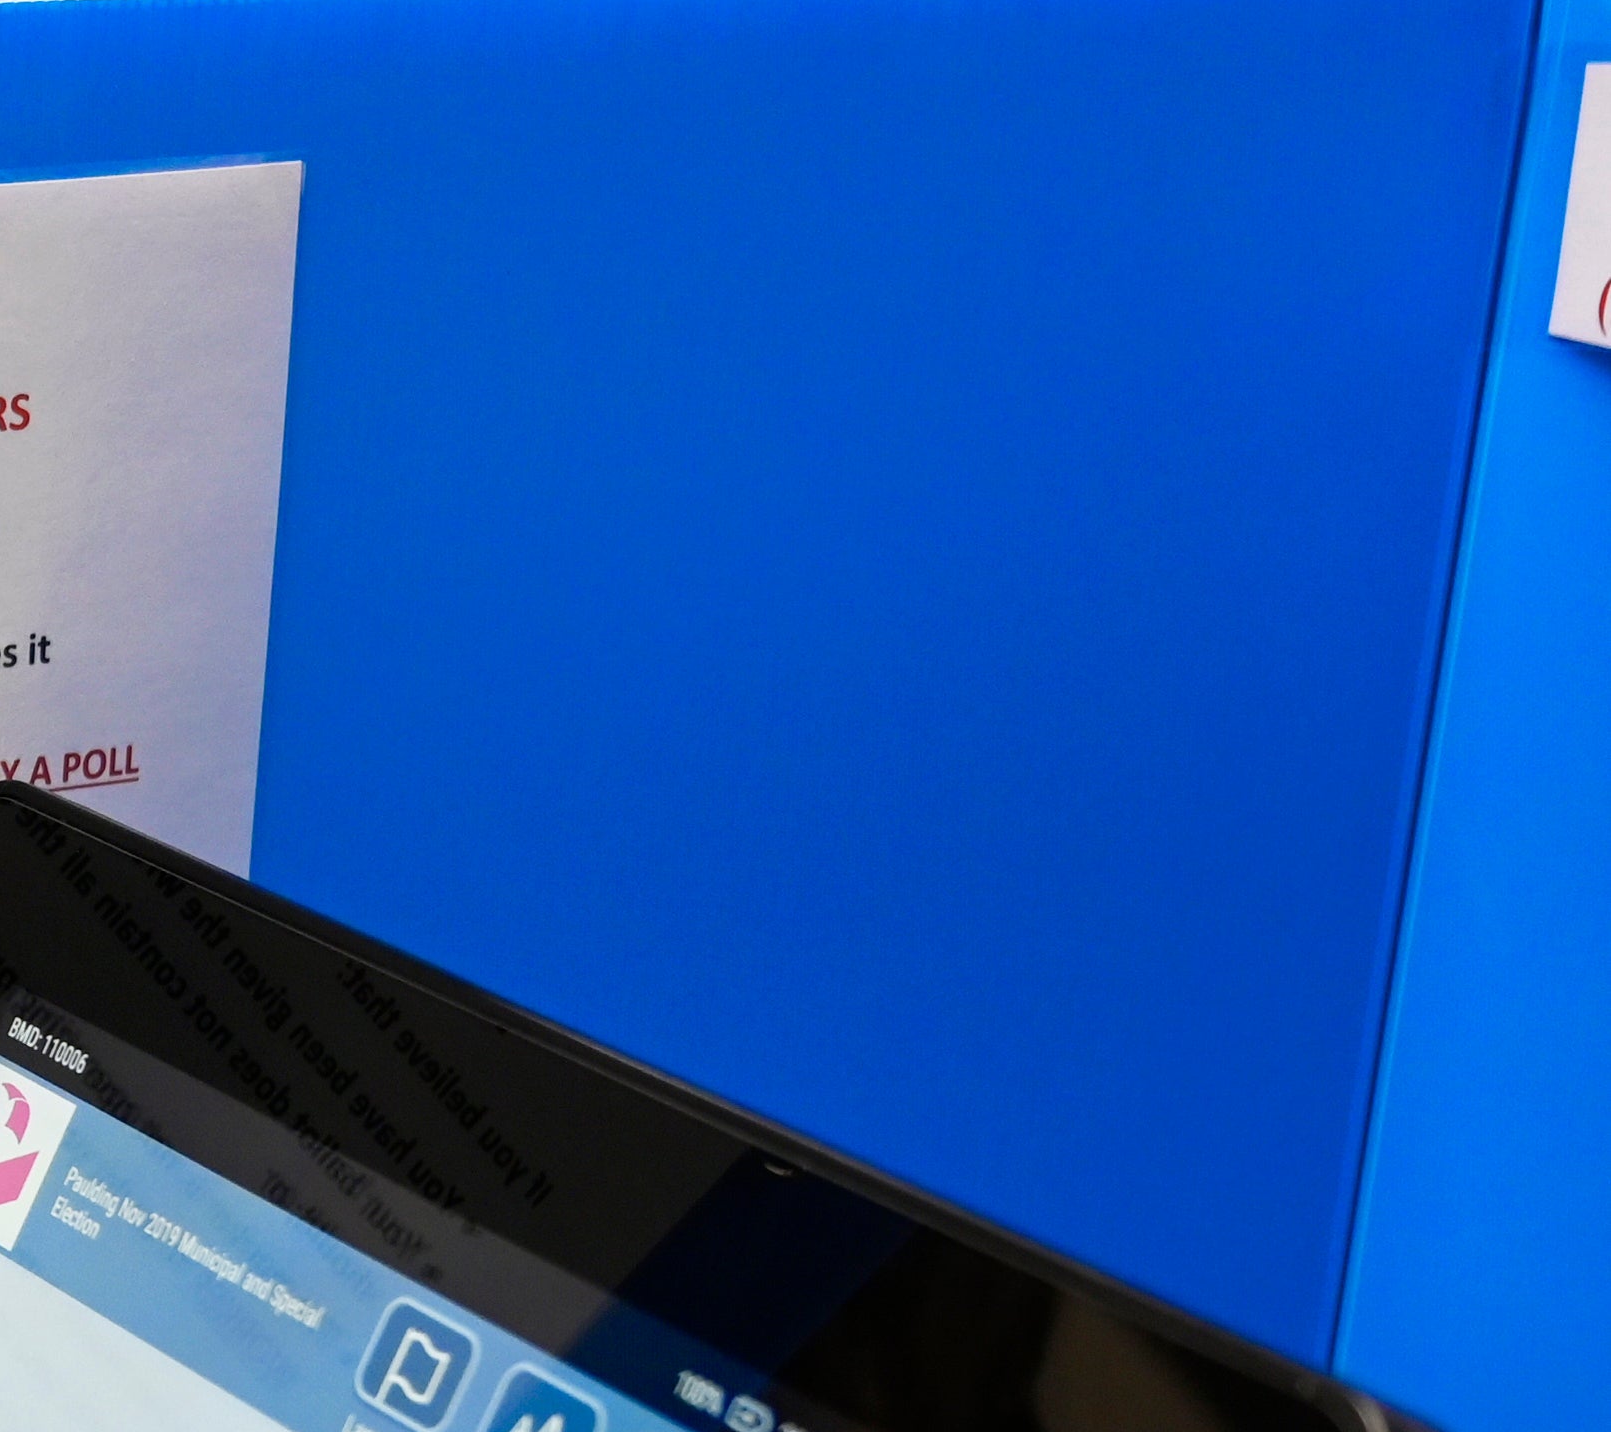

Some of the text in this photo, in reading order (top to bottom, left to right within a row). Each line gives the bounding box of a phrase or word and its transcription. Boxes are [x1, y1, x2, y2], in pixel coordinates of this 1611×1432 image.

[27, 632, 52, 666] it
[30, 754, 52, 783] A
[61, 744, 139, 779] POLL
[7, 1016, 90, 1075] BMD: 110006
[50, 1196, 102, 1242] Election
[63, 1165, 328, 1332] Paulding Nov 2019 Municipal and Special
